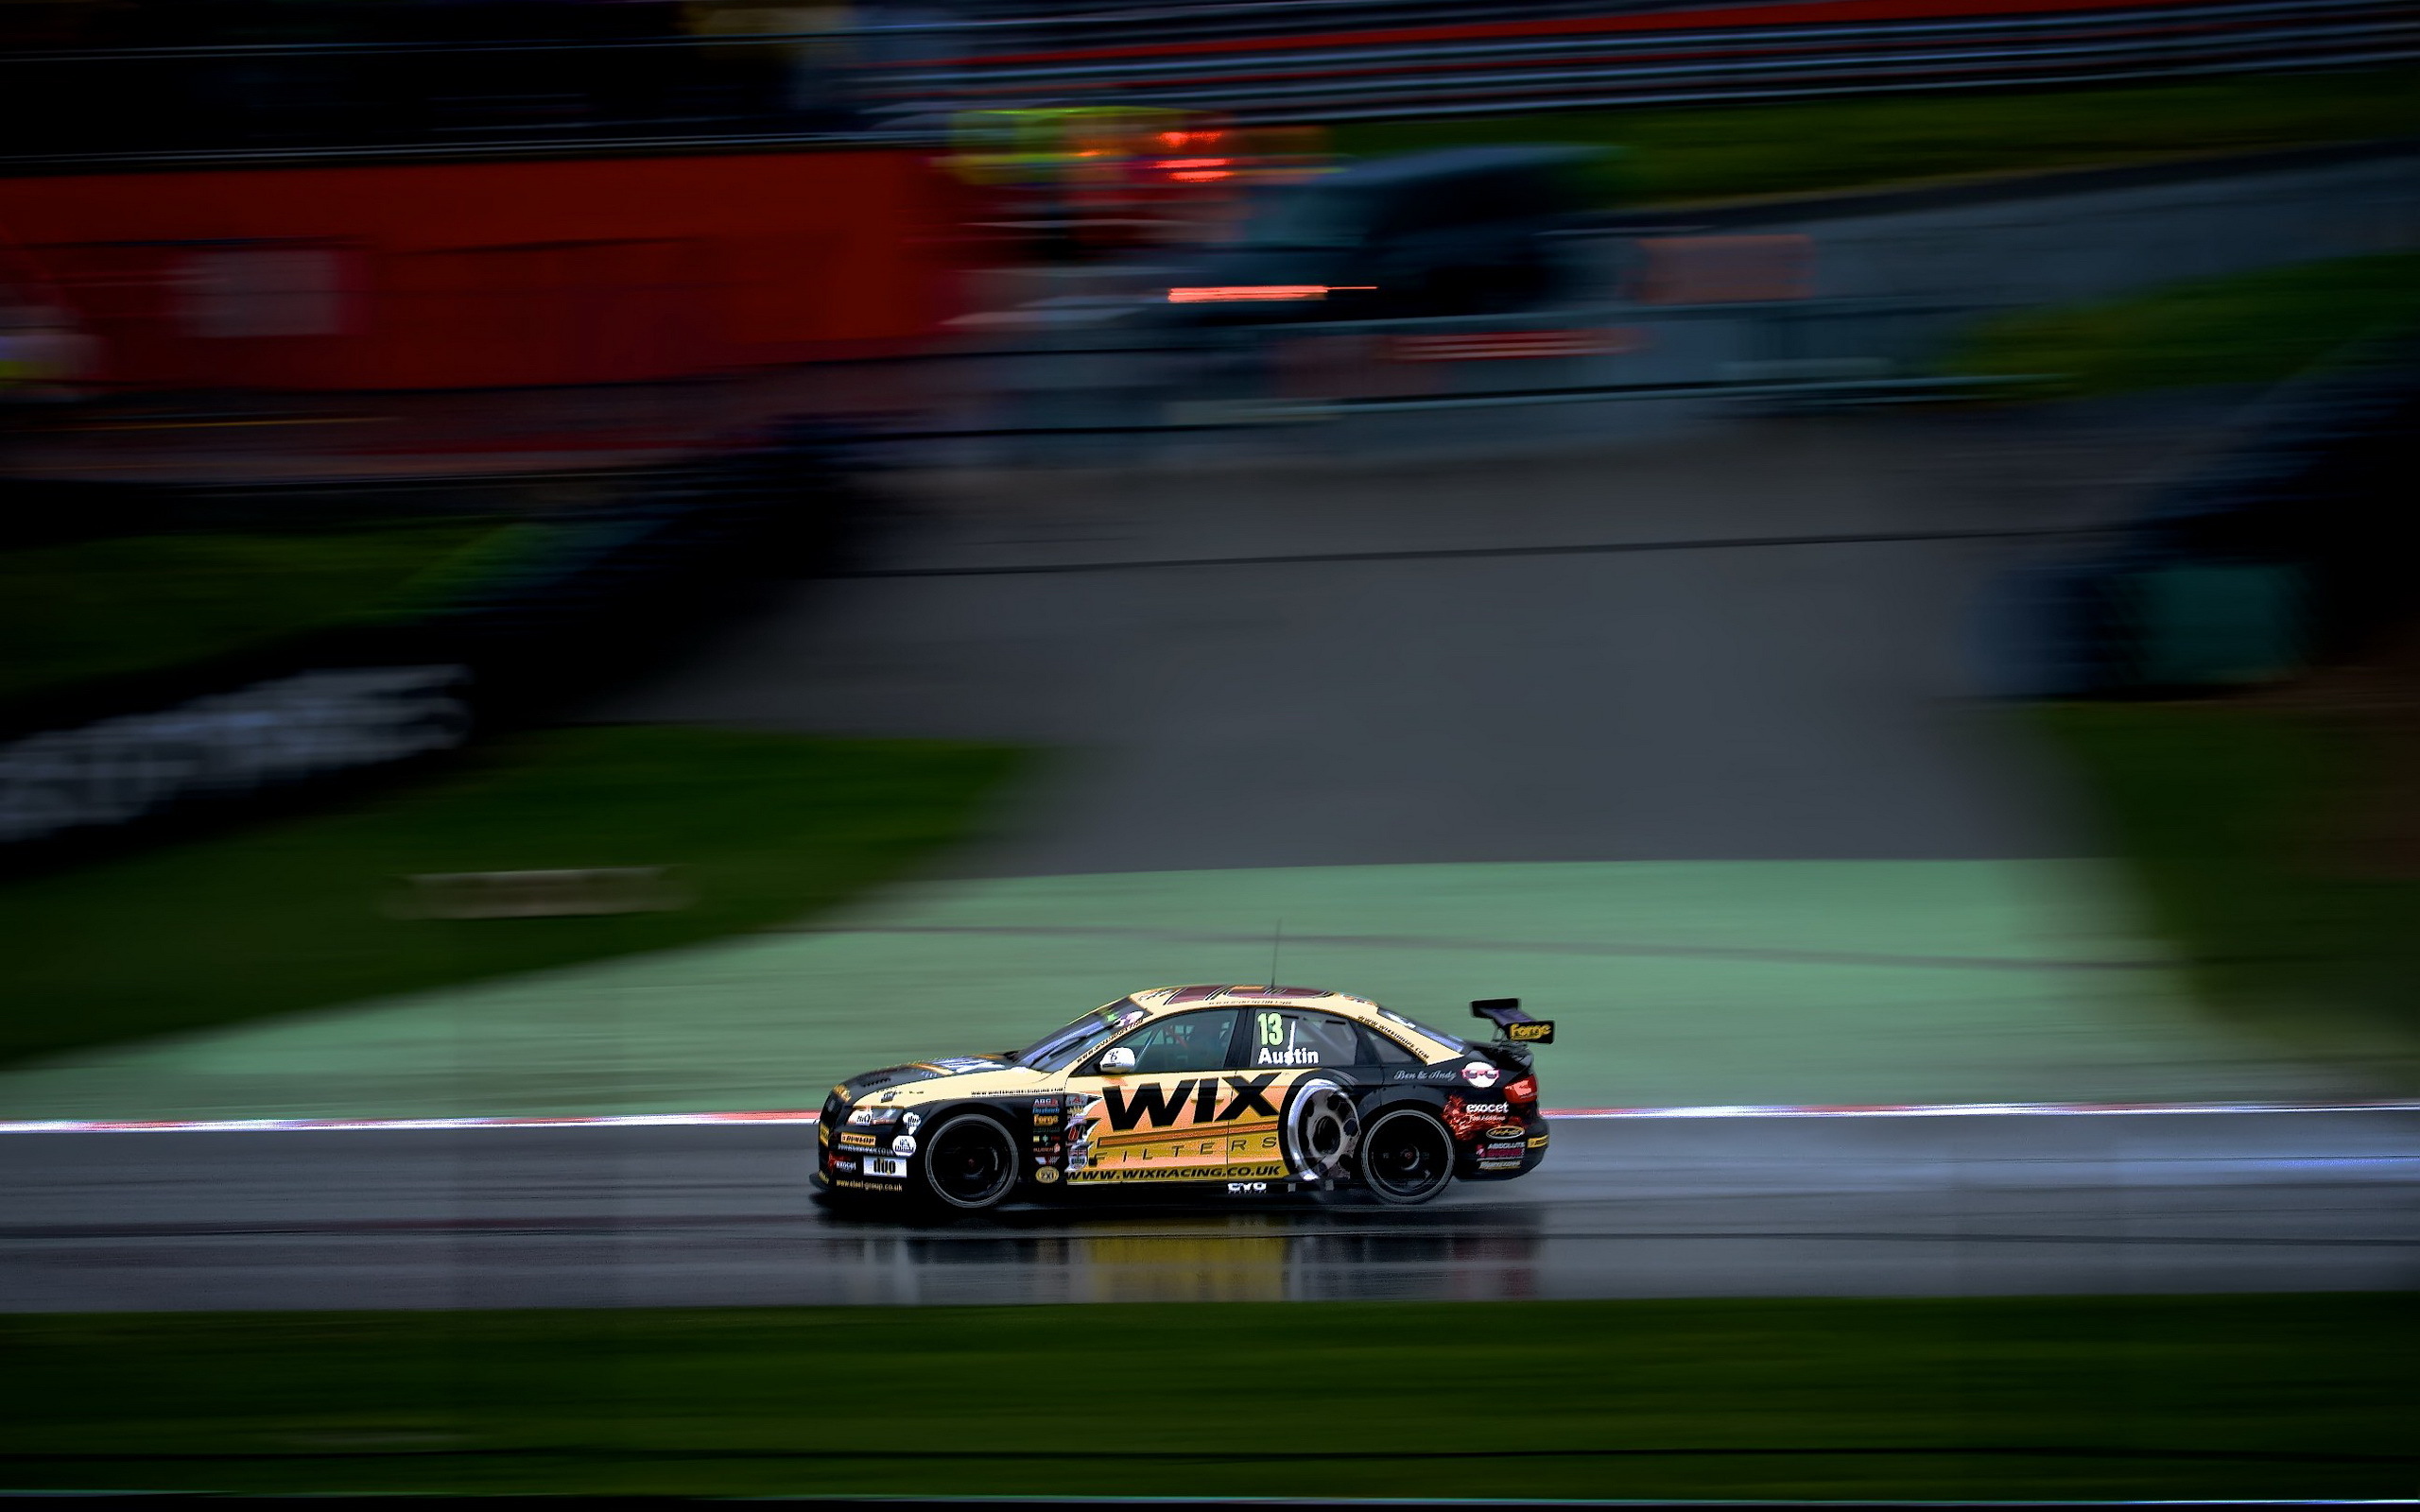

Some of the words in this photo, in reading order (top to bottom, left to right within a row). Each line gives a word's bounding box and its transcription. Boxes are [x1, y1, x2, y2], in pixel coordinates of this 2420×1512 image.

[1257, 1012, 1284, 1045] 13
[1510, 1022, 1551, 1040] Forge
[1257, 1047, 1319, 1066] Austin
[1102, 1072, 1282, 1131] WIX
[1466, 1101, 1510, 1113] exocet
[1091, 1137, 1277, 1163] FILTERS
[1066, 1166, 1280, 1180] WWW.WIXRACING.CO.UK
